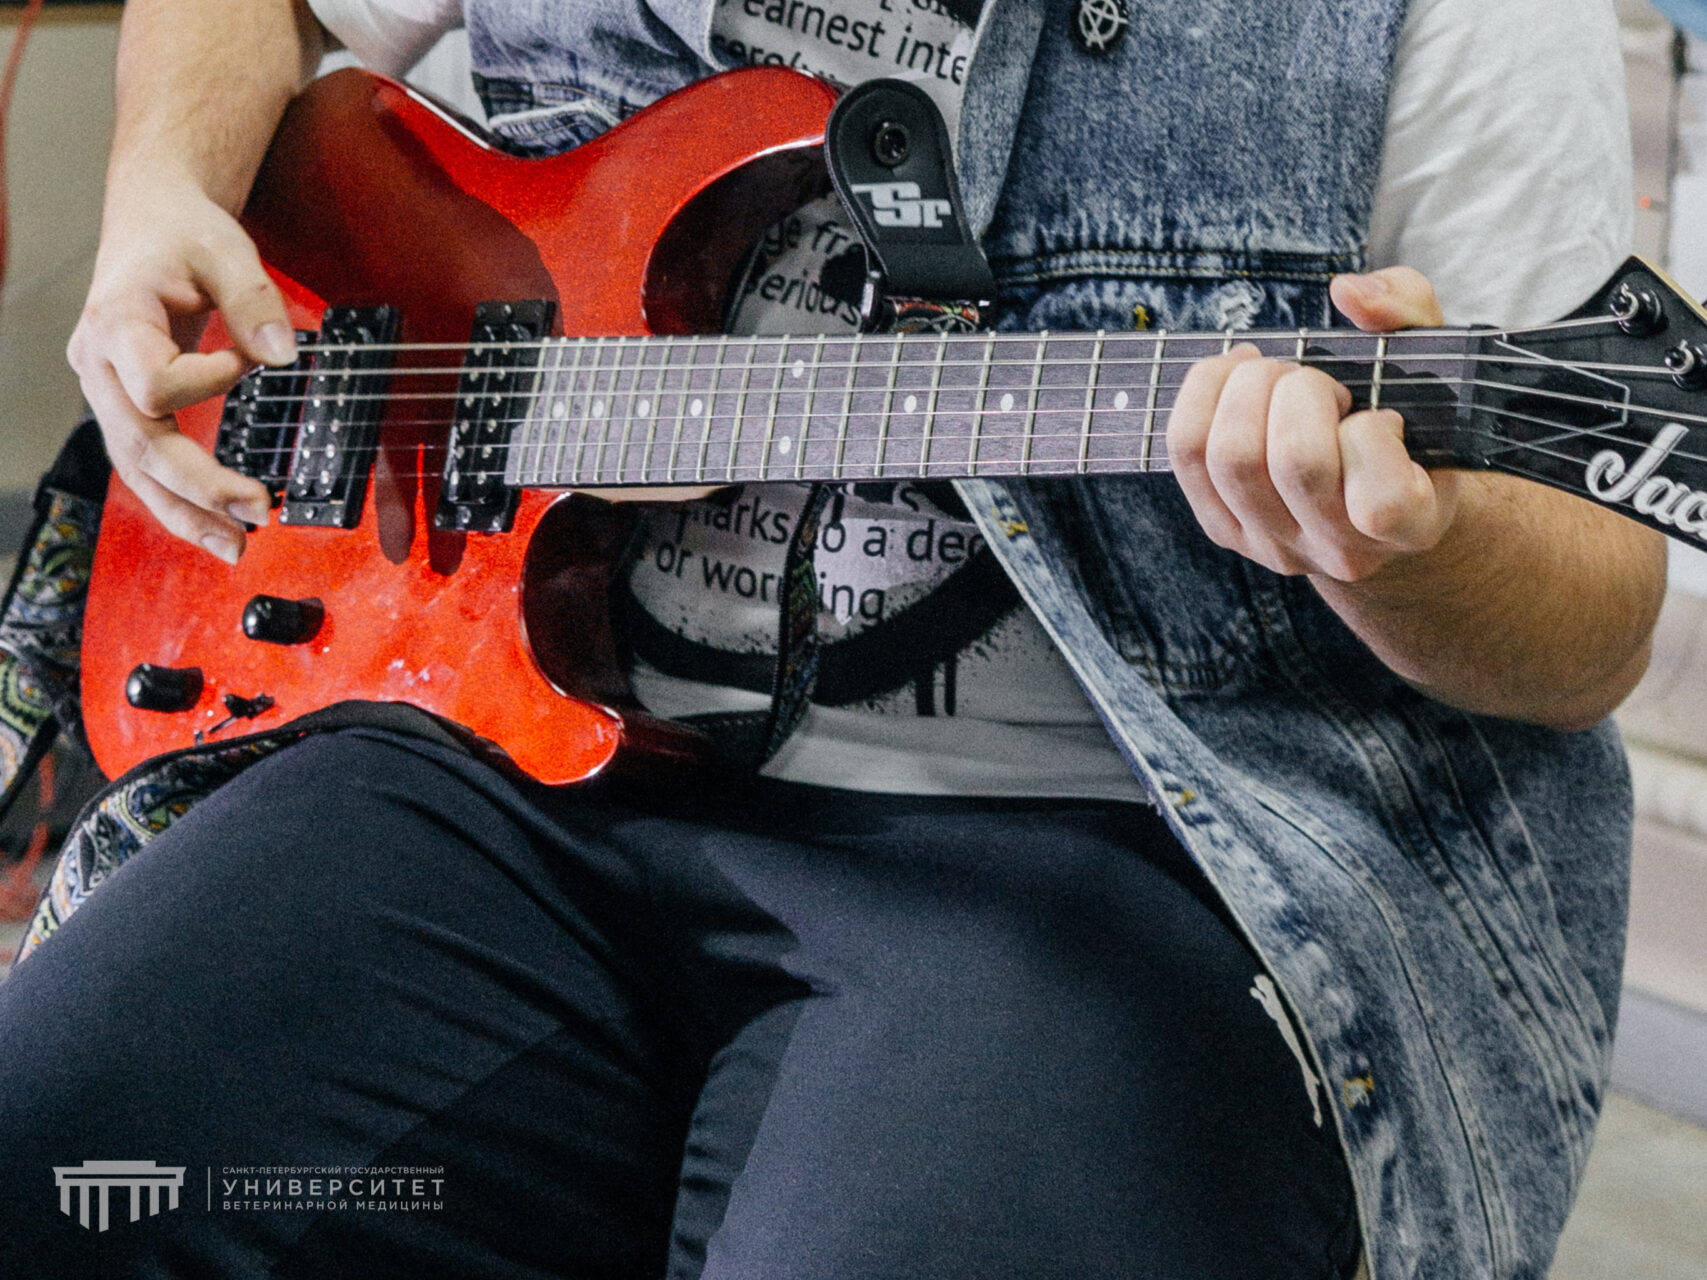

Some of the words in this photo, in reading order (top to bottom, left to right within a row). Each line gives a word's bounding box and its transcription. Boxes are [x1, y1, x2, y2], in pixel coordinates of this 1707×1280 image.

[745, 269, 862, 326] erious
[1585, 423, 1707, 540] Jac
[680, 496, 789, 544] arks
[862, 525, 888, 558] a
[656, 541, 692, 578] or
[703, 555, 885, 622] woring
